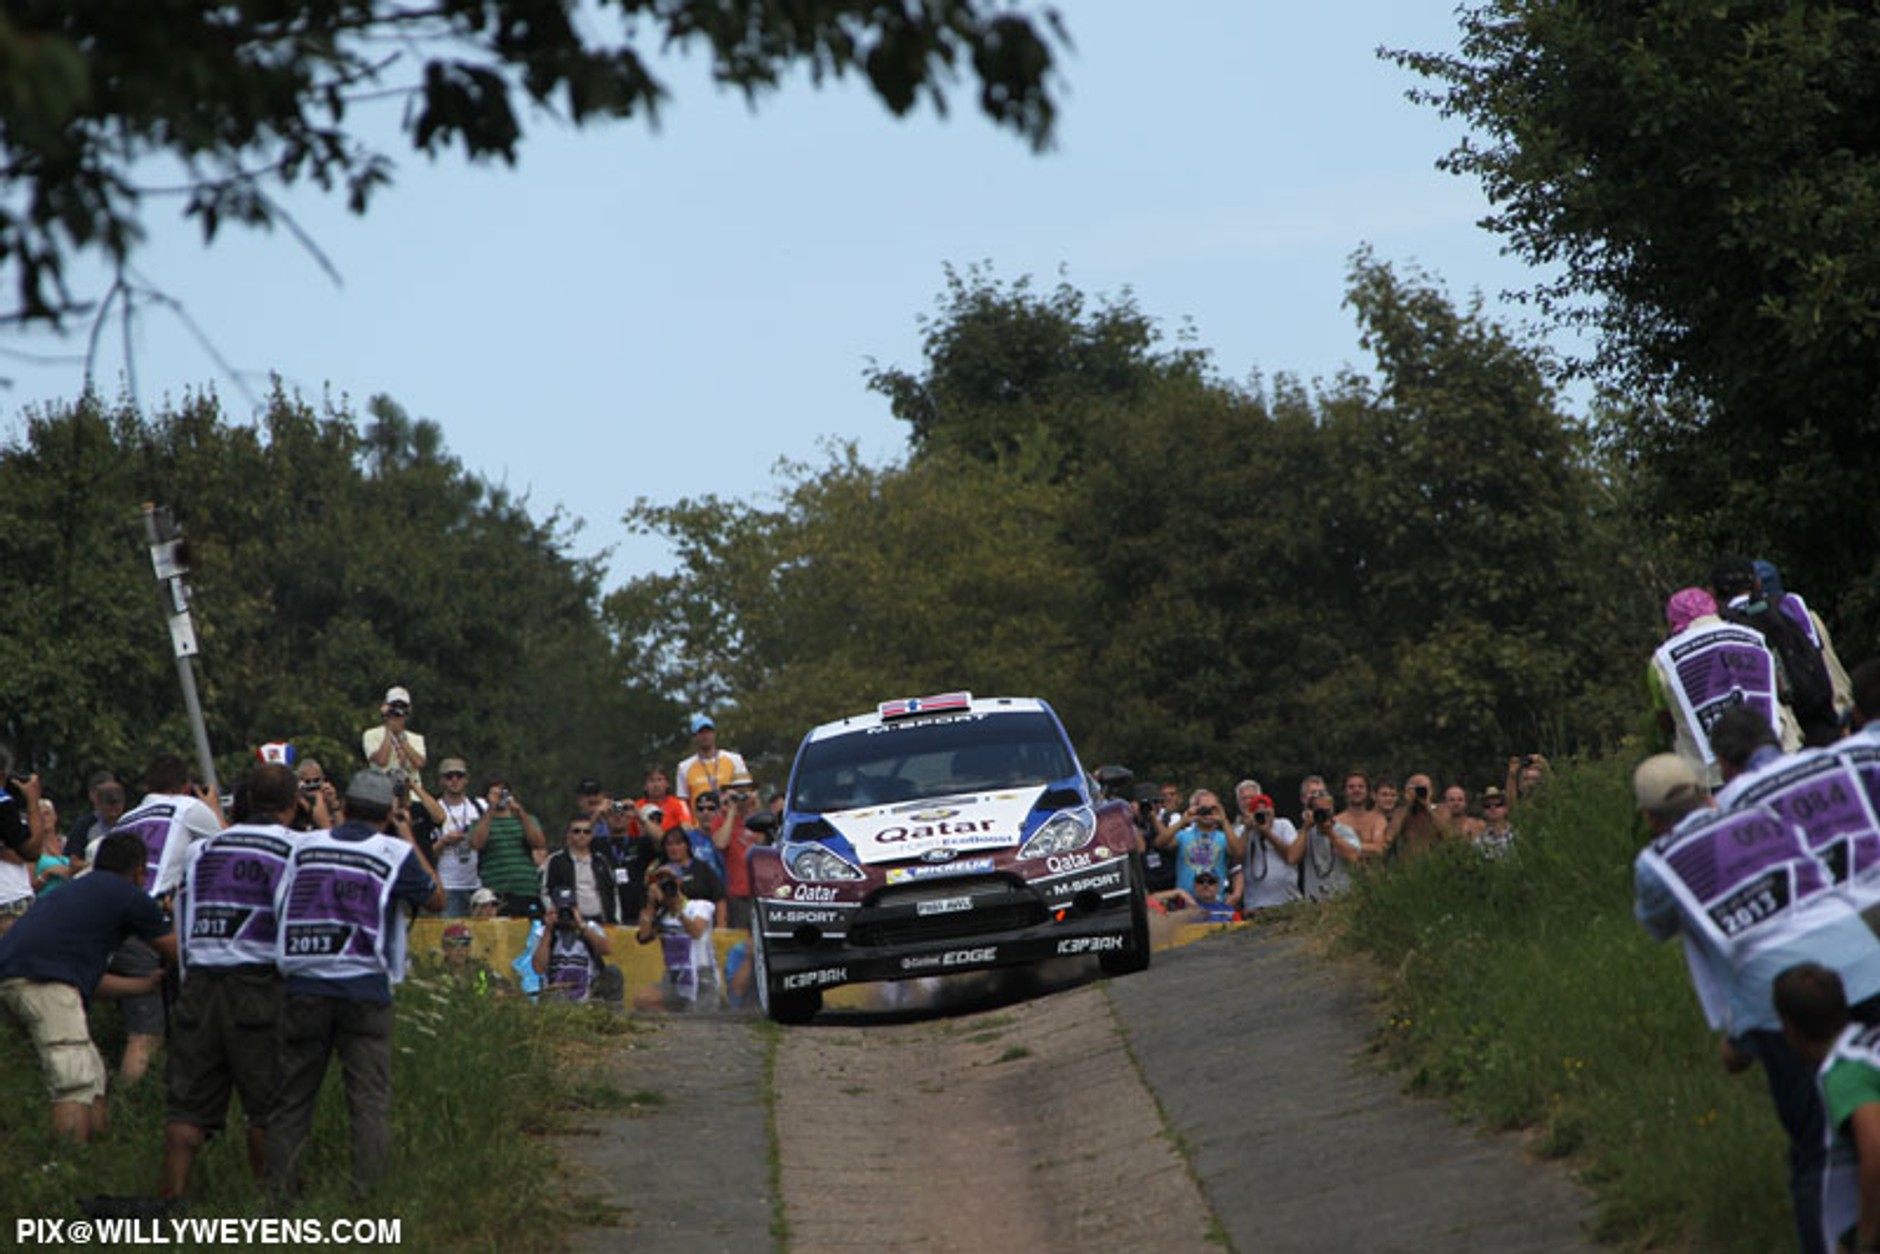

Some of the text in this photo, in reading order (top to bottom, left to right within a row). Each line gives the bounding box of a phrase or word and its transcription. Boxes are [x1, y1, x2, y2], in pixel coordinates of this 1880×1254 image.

[875, 819, 996, 843] Qatar
[1045, 853, 1092, 874] Qatar
[793, 883, 840, 901] Qatar
[1054, 873, 1121, 895] M-SPORT
[768, 910, 838, 923] M-SPORT
[1721, 890, 1777, 933] 2013
[193, 918, 226, 934] 2013
[289, 936, 332, 953] 2013
[942, 946, 998, 966] EDGE
